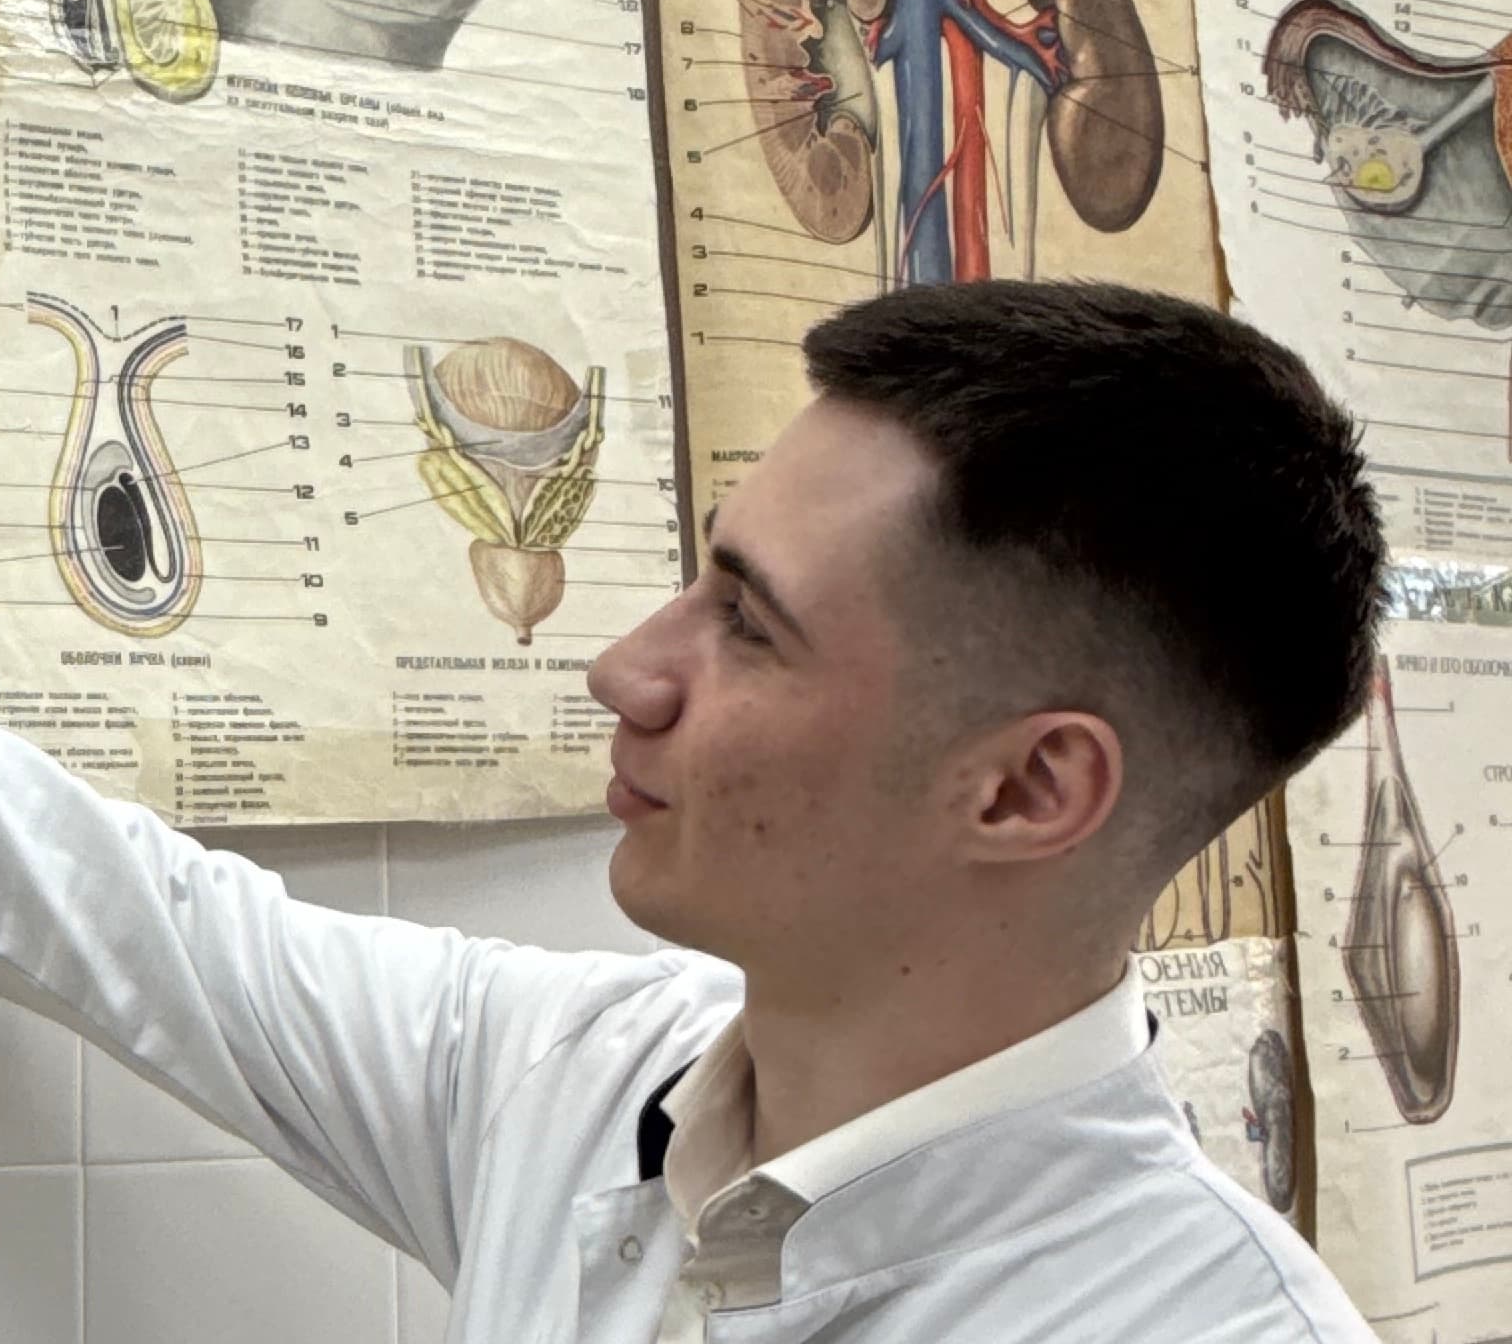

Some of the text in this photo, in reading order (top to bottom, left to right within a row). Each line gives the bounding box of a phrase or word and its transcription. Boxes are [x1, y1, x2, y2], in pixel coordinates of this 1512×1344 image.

[623, 41, 642, 56] 17
[681, 57, 692, 70] 7
[1240, 83, 1255, 95] 10
[690, 207, 703, 221] 4
[692, 245, 707, 258] 3
[693, 283, 708, 296] 2
[111, 305, 118, 321] 1
[286, 317, 303, 332] 17
[332, 324, 339, 338] 1
[691, 331, 704, 345] 1
[285, 344, 304, 359] 16
[333, 363, 346, 377] 2
[285, 371, 305, 386] 15
[658, 395, 671, 408] 11
[287, 403, 307, 418] 14
[337, 413, 351, 427] 3
[289, 435, 310, 449] 13
[340, 455, 352, 468] 4
[293, 485, 314, 499] 12
[345, 511, 358, 525] 5
[304, 537, 319, 551] 11
[301, 573, 323, 587] 10
[313, 613, 327, 626] 9
[1139, 951, 1228, 982] ОЕНИЯ
